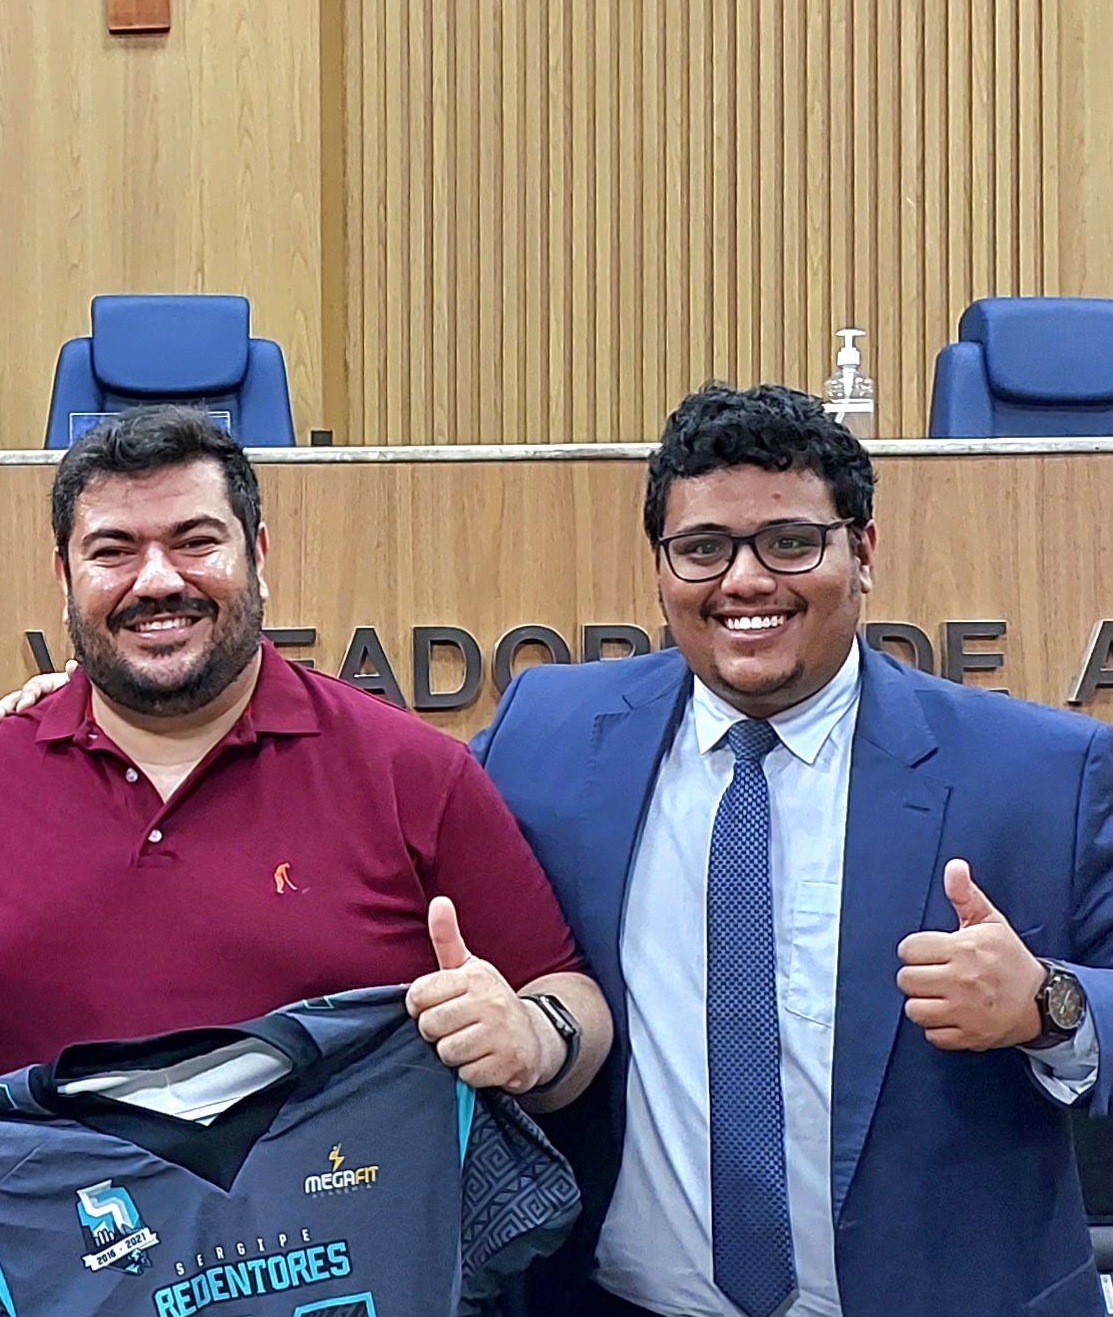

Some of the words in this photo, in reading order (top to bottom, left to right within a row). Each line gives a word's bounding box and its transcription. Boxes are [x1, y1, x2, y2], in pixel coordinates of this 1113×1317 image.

[304, 1165, 379, 1194] MEGAFIT
[124, 1231, 147, 1250] 2021
[175, 1228, 312, 1276] SERGIPE
